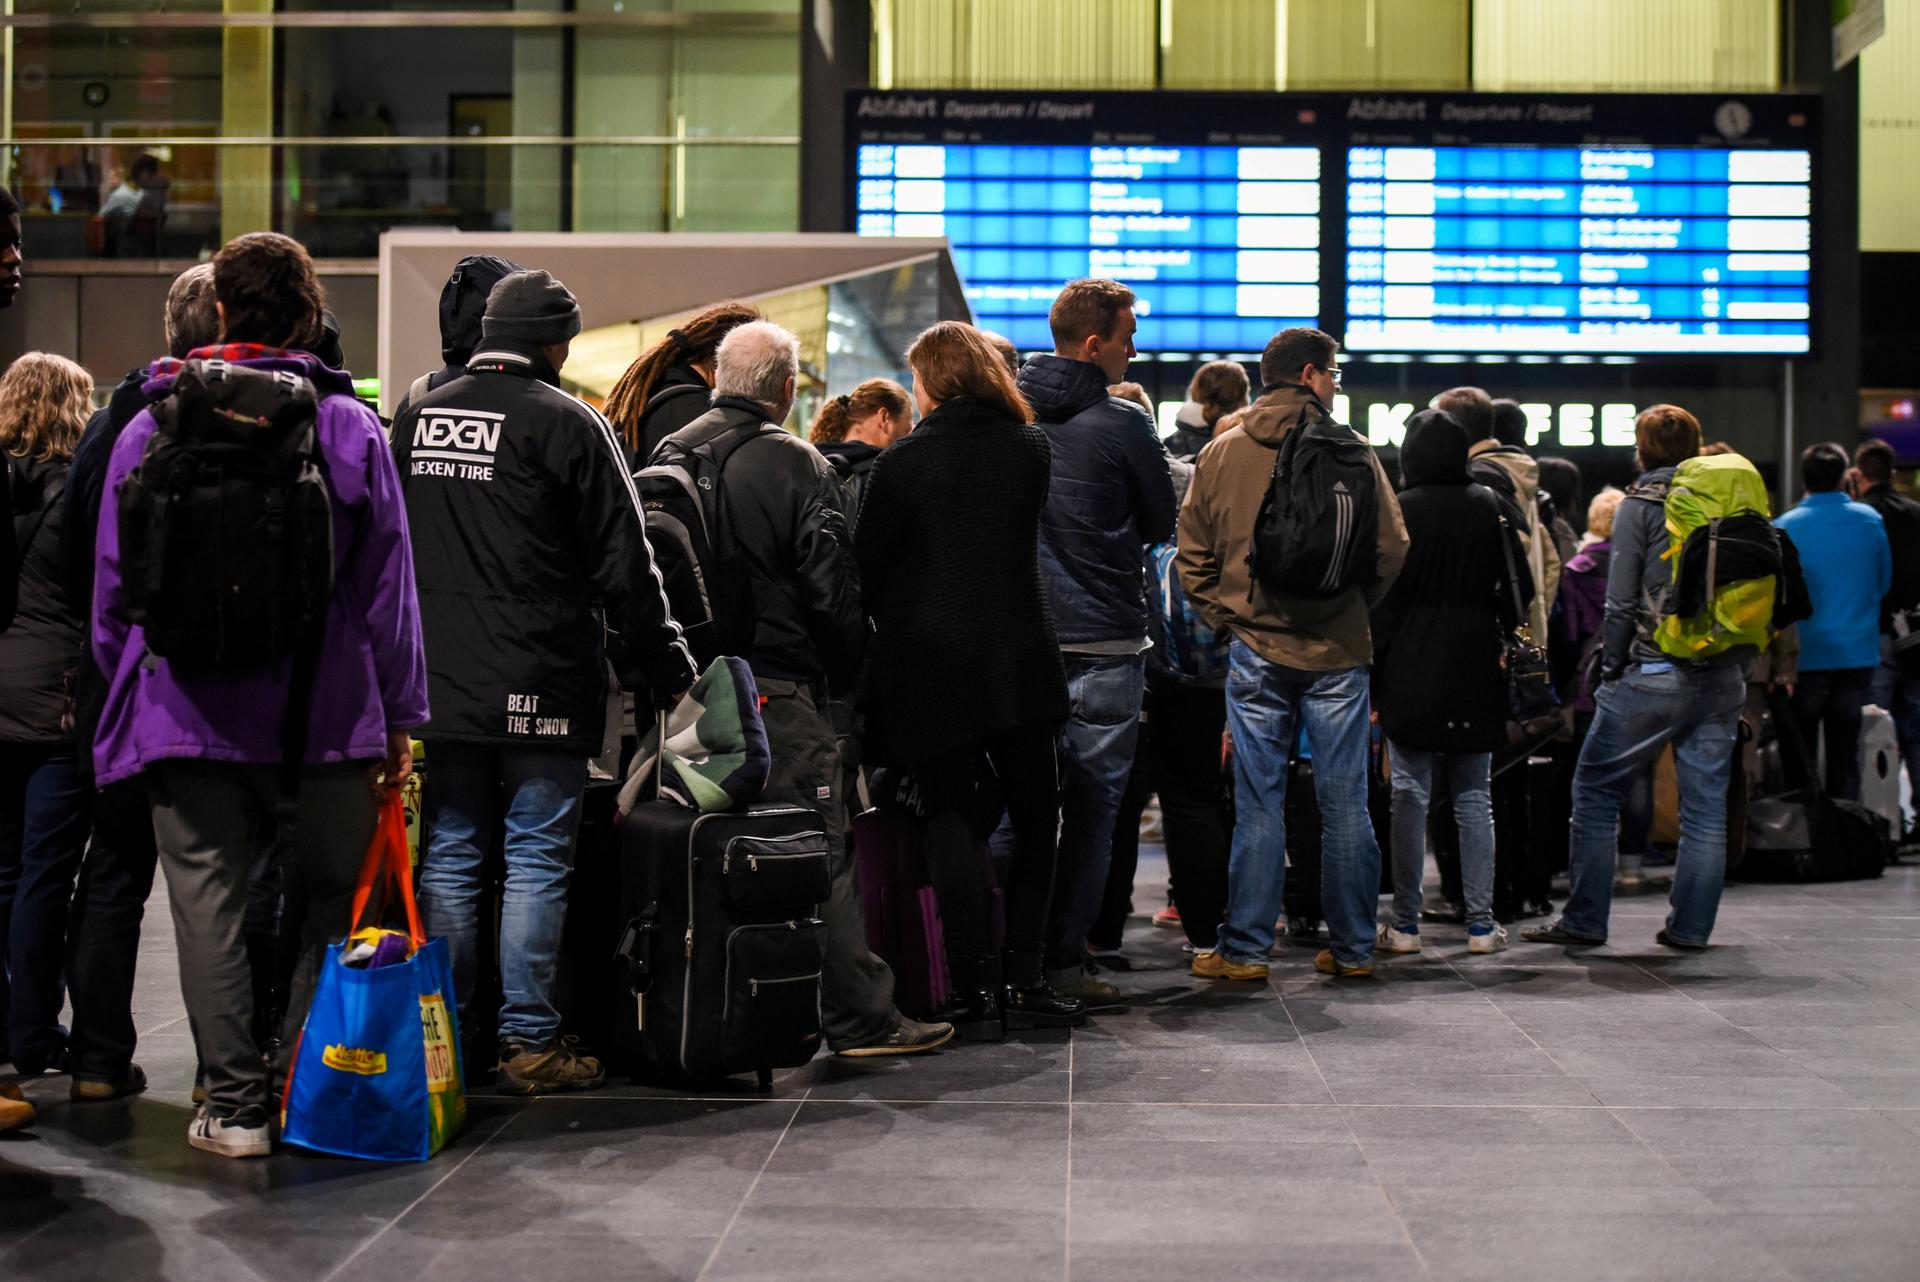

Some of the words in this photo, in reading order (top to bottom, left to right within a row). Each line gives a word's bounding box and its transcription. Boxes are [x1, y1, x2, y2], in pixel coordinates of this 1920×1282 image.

[412, 417, 502, 452] NEXEN
[1368, 403, 1637, 447] KFEE
[411, 461, 455, 477] NEXEN
[458, 464, 494, 481] TIRE
[507, 693, 539, 713] BEAT
[507, 715, 530, 734] THE
[535, 717, 569, 735] SNOW
